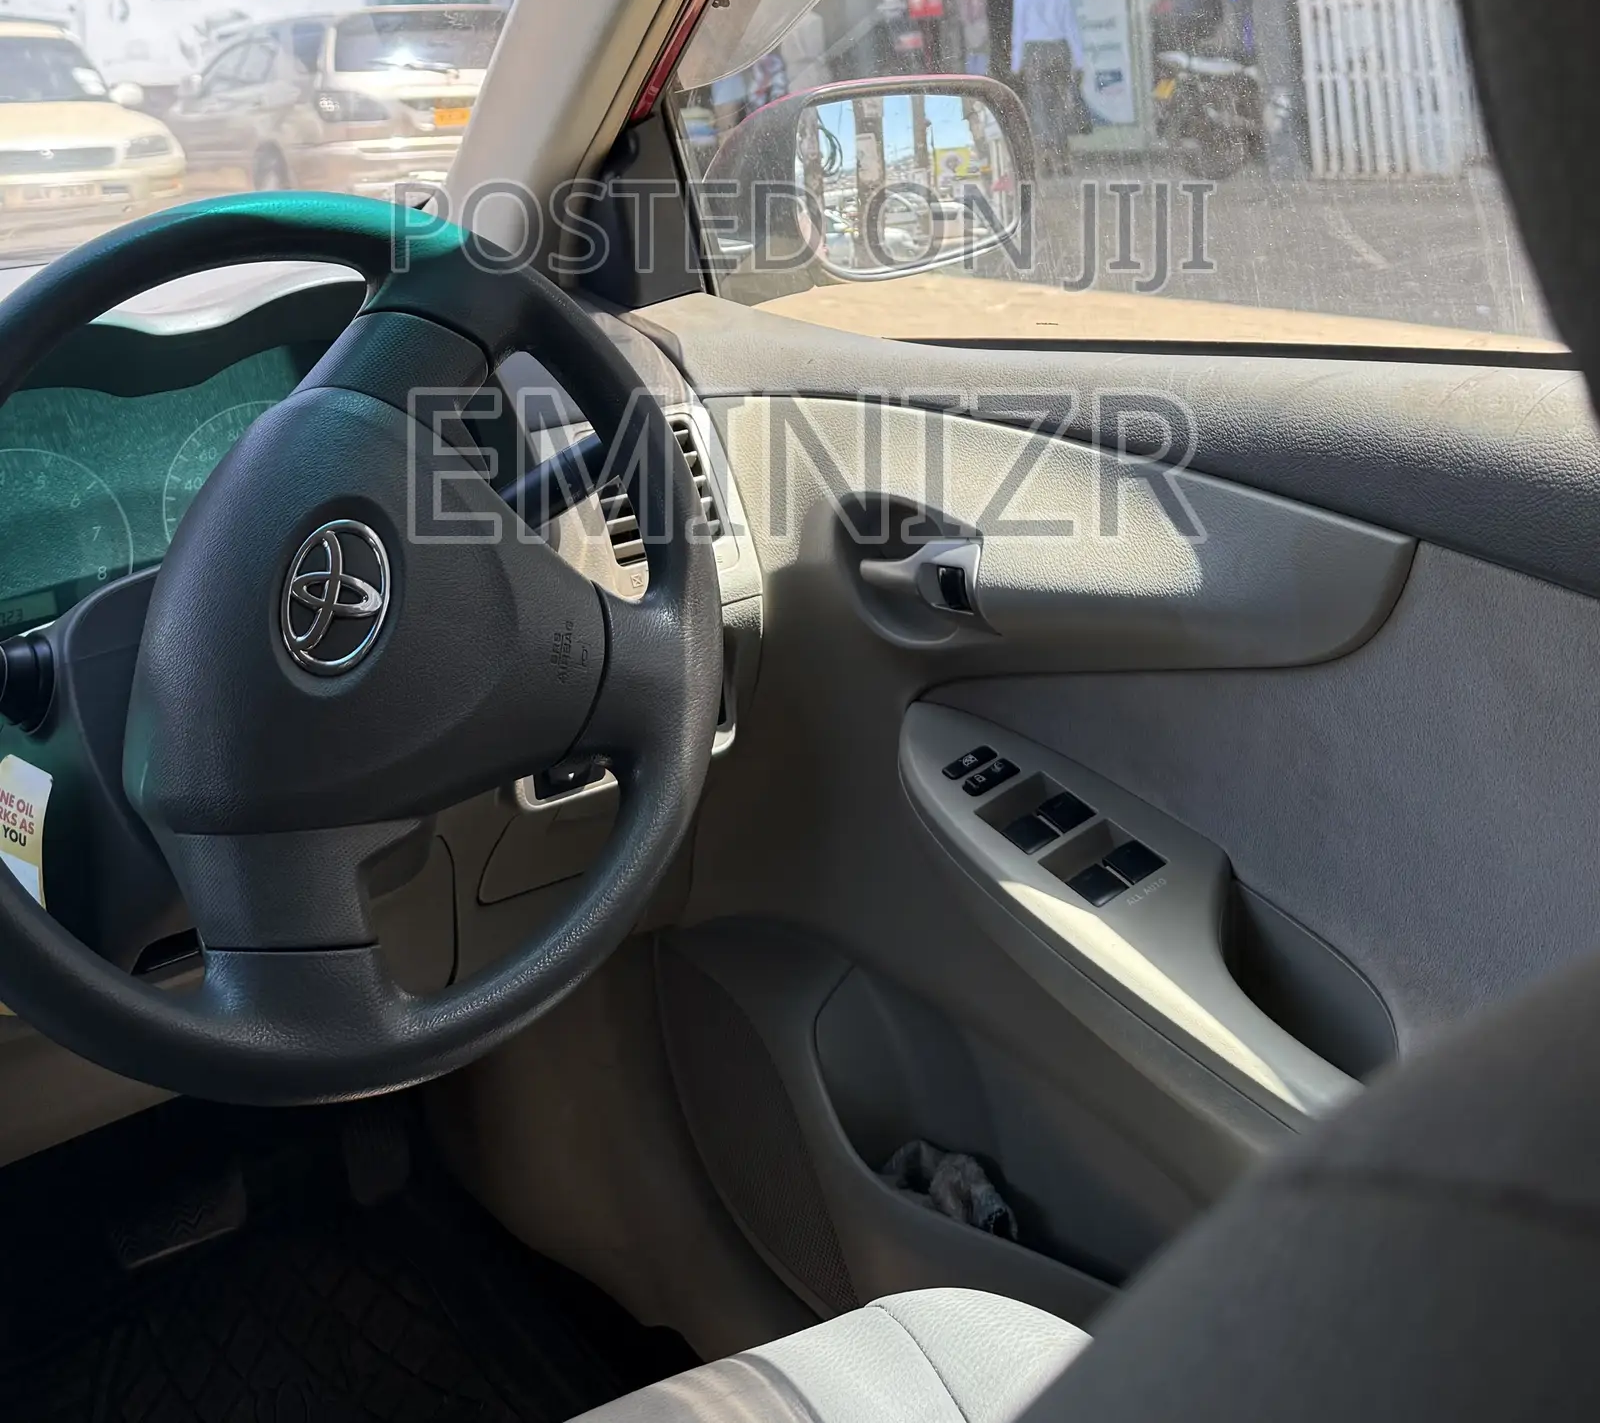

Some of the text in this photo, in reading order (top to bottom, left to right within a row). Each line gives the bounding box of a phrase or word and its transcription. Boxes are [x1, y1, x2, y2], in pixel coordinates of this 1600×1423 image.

[92, 525, 102, 542] 7
[97, 564, 108, 581] 8
[0, 789, 34, 818] NE OIL
[19, 818, 35, 835] AS
[3, 824, 26, 847] YOU
